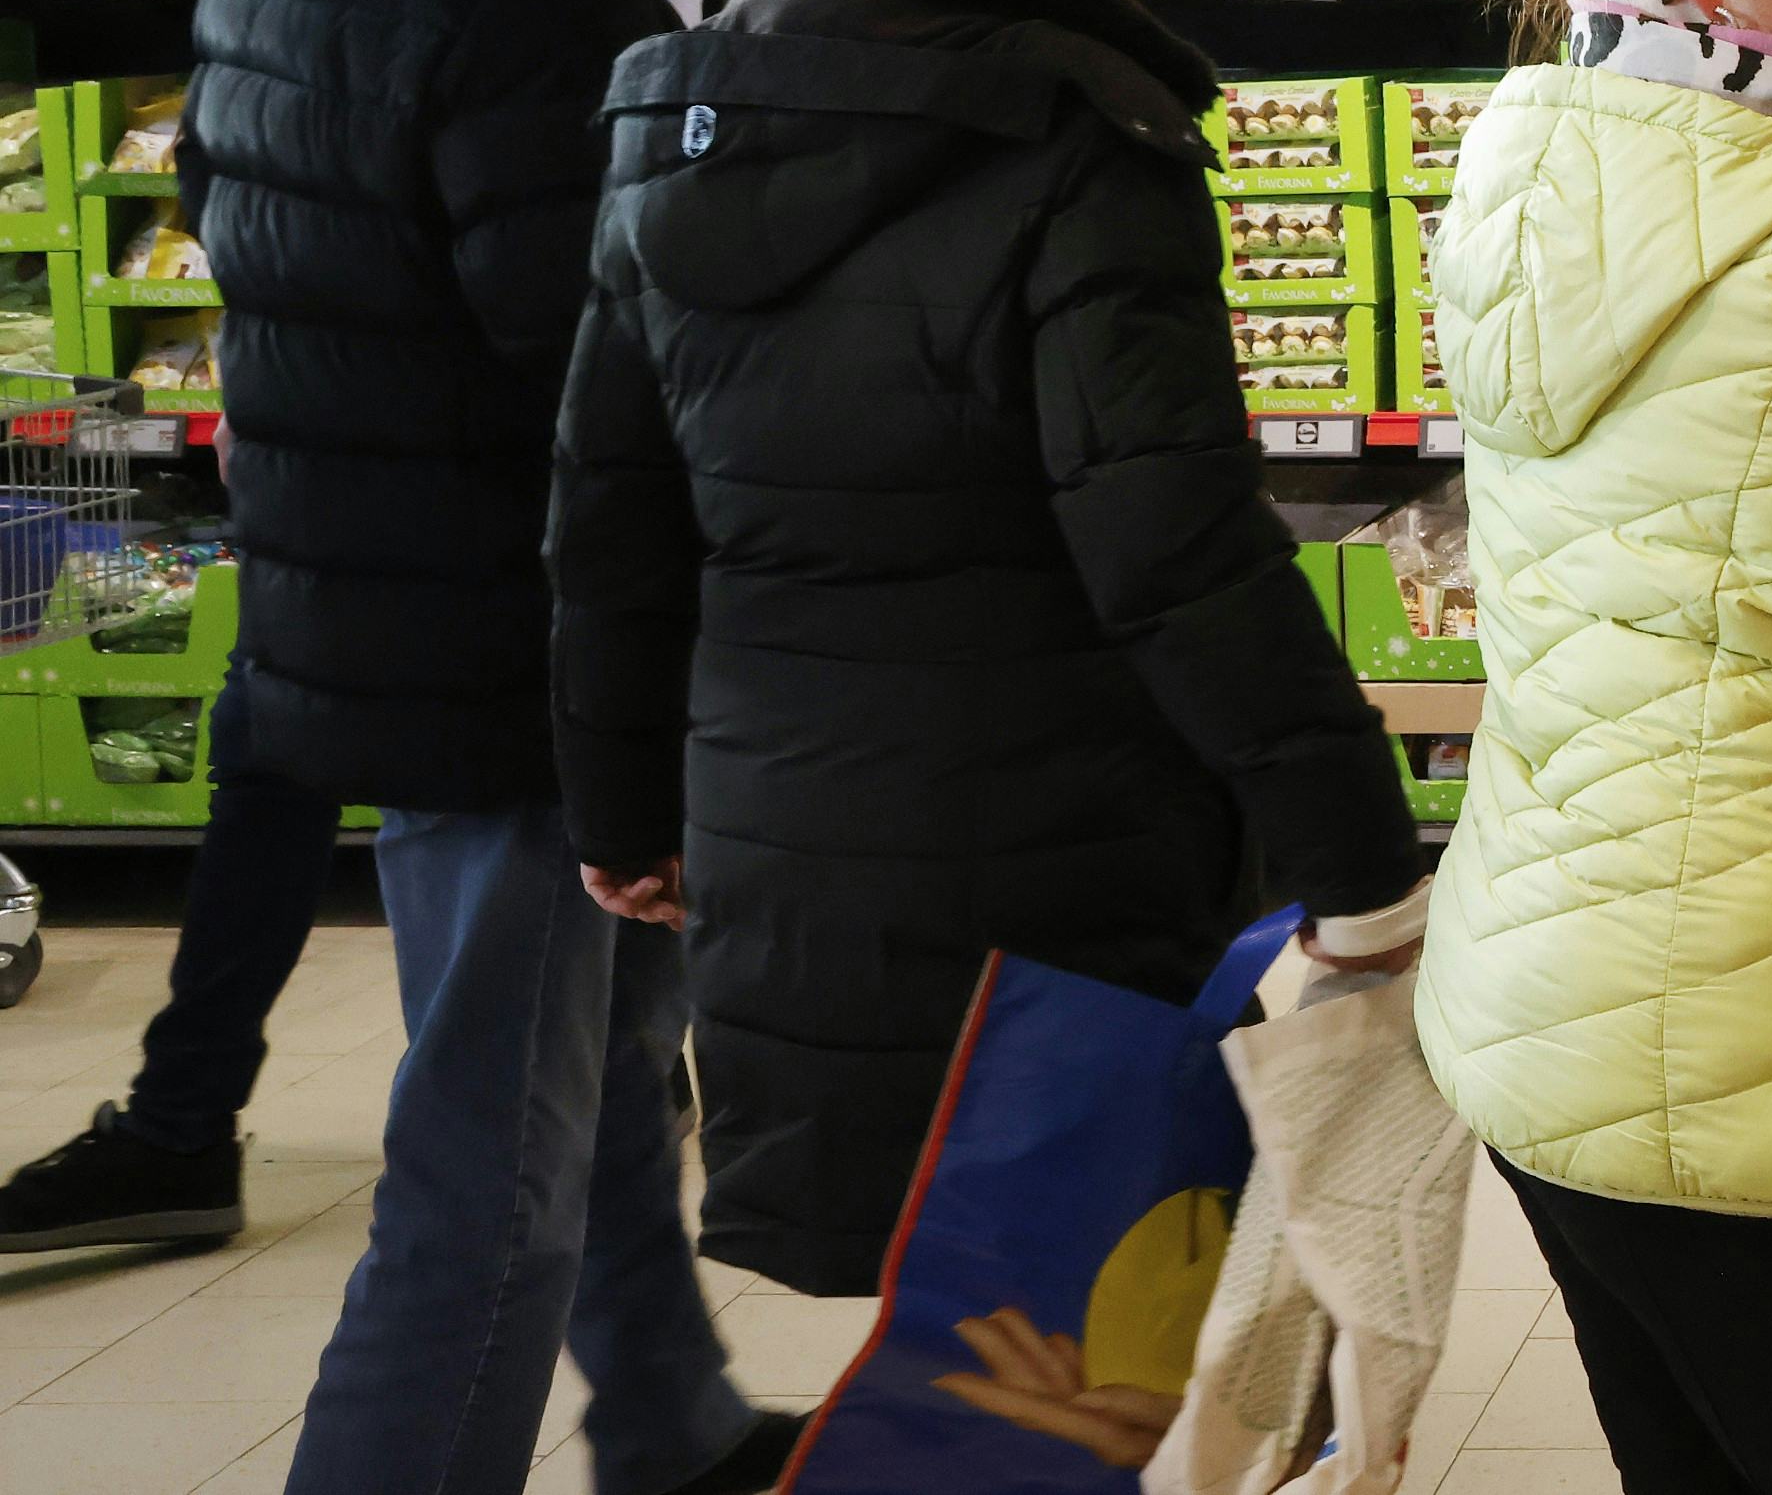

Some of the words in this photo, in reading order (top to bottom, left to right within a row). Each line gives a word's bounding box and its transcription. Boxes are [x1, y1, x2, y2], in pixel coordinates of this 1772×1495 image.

[1257, 176, 1313, 189] FAVORINA
[130, 283, 214, 304] FAVORINA
[1262, 288, 1318, 302] FAVORINA
[147, 398, 221, 411] AVORINA
[1262, 396, 1318, 410] FAVORINA
